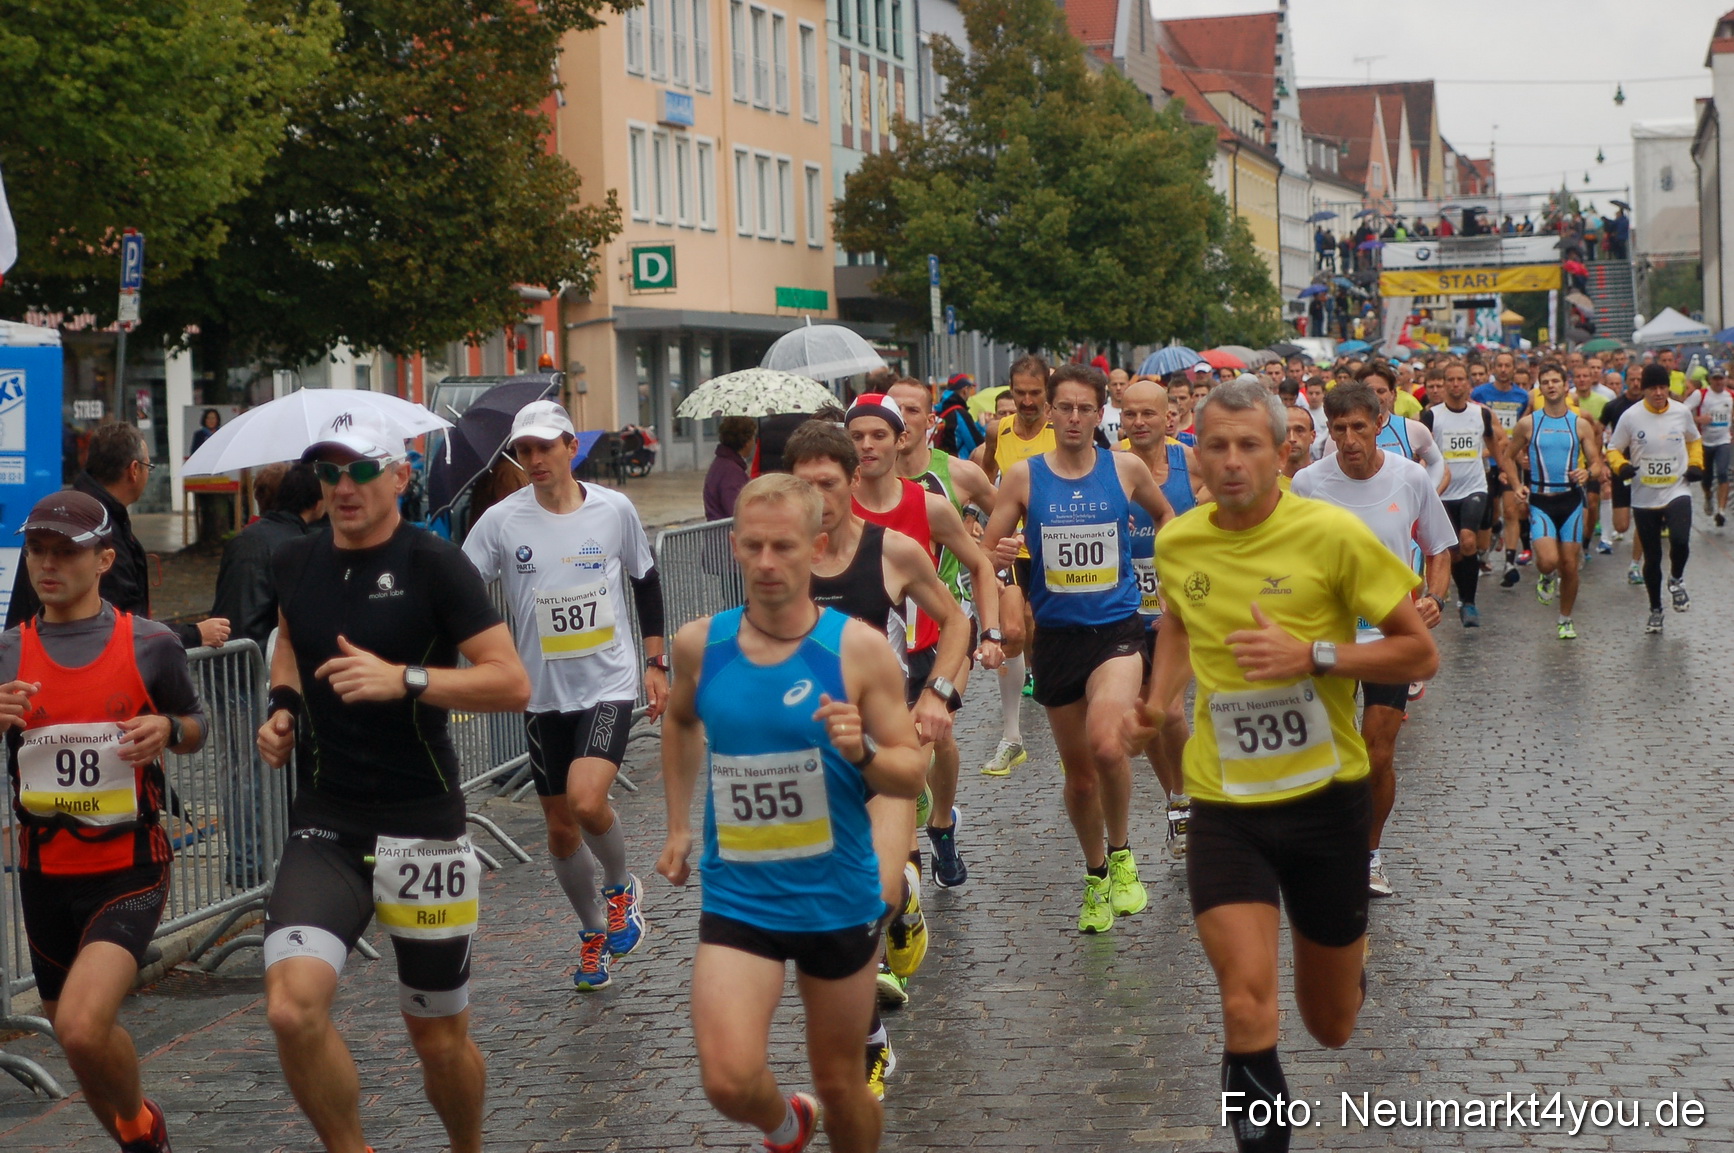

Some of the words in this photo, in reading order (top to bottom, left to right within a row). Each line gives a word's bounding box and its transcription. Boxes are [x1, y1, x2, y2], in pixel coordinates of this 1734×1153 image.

[126, 242, 139, 283] P
[638, 252, 669, 283] D
[1439, 273, 1499, 290] START
[1450, 437, 1473, 449] 506
[1648, 463, 1671, 475] 526
[1049, 502, 1108, 513] ELOTEC
[1058, 541, 1104, 567] 500
[1066, 573, 1097, 583] Martin
[536, 597, 560, 605] PARTL
[561, 591, 597, 603] Neumarkt
[551, 601, 597, 633] 587
[1210, 702, 1244, 712] PARTL
[1247, 696, 1301, 710] Neumarkt
[592, 703, 618, 752] 2XU
[1233, 710, 1308, 753] 539
[60, 733, 113, 744] Neumarkt
[56, 749, 100, 787] 98
[713, 764, 742, 777] PARTL
[744, 764, 800, 777] Neumarkt
[55, 797, 100, 813] Hynek
[731, 780, 803, 821] 555
[378, 847, 414, 857] PARTL
[398, 860, 465, 899] 246
[417, 909, 446, 925] Ralf
